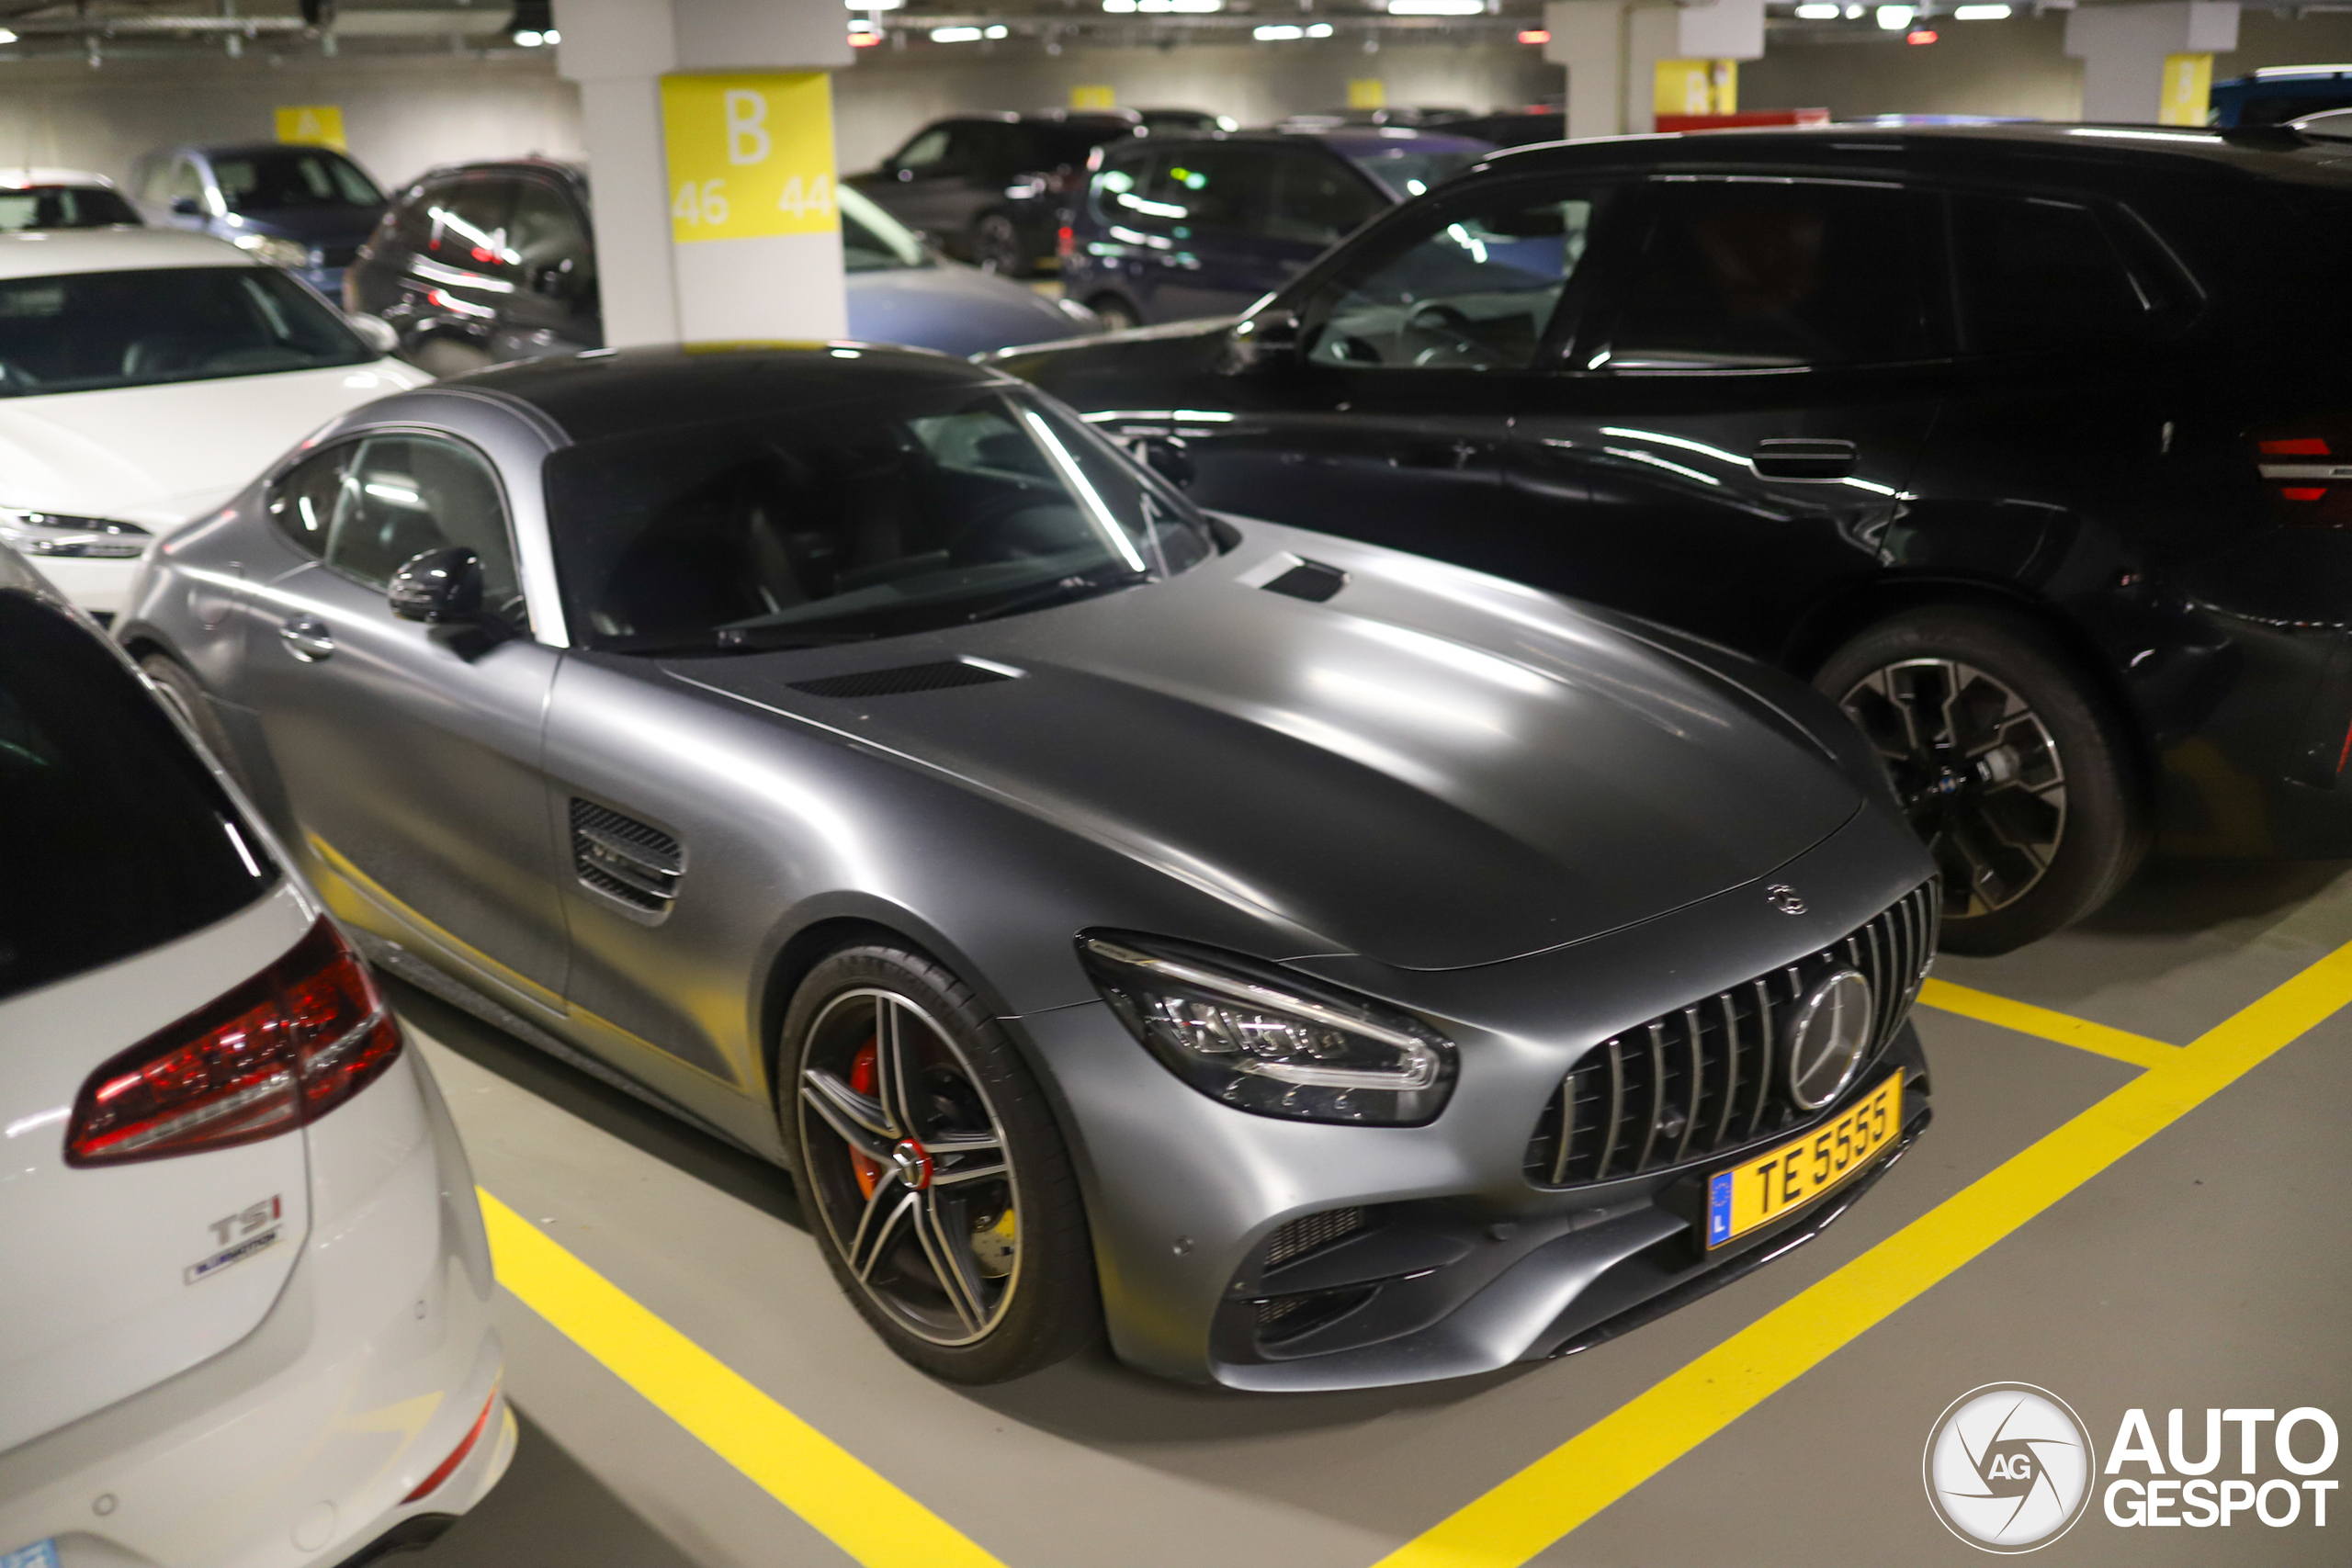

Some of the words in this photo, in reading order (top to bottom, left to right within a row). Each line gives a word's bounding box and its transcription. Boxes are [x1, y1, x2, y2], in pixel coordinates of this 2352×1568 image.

[724, 87, 772, 165] B
[673, 178, 730, 227] 46
[778, 173, 832, 220] 44
[1757, 1147, 1804, 1214] TE
[1813, 1089, 1887, 1185] 5555
[208, 1193, 281, 1246] TSI
[1713, 1215, 1725, 1233] L
